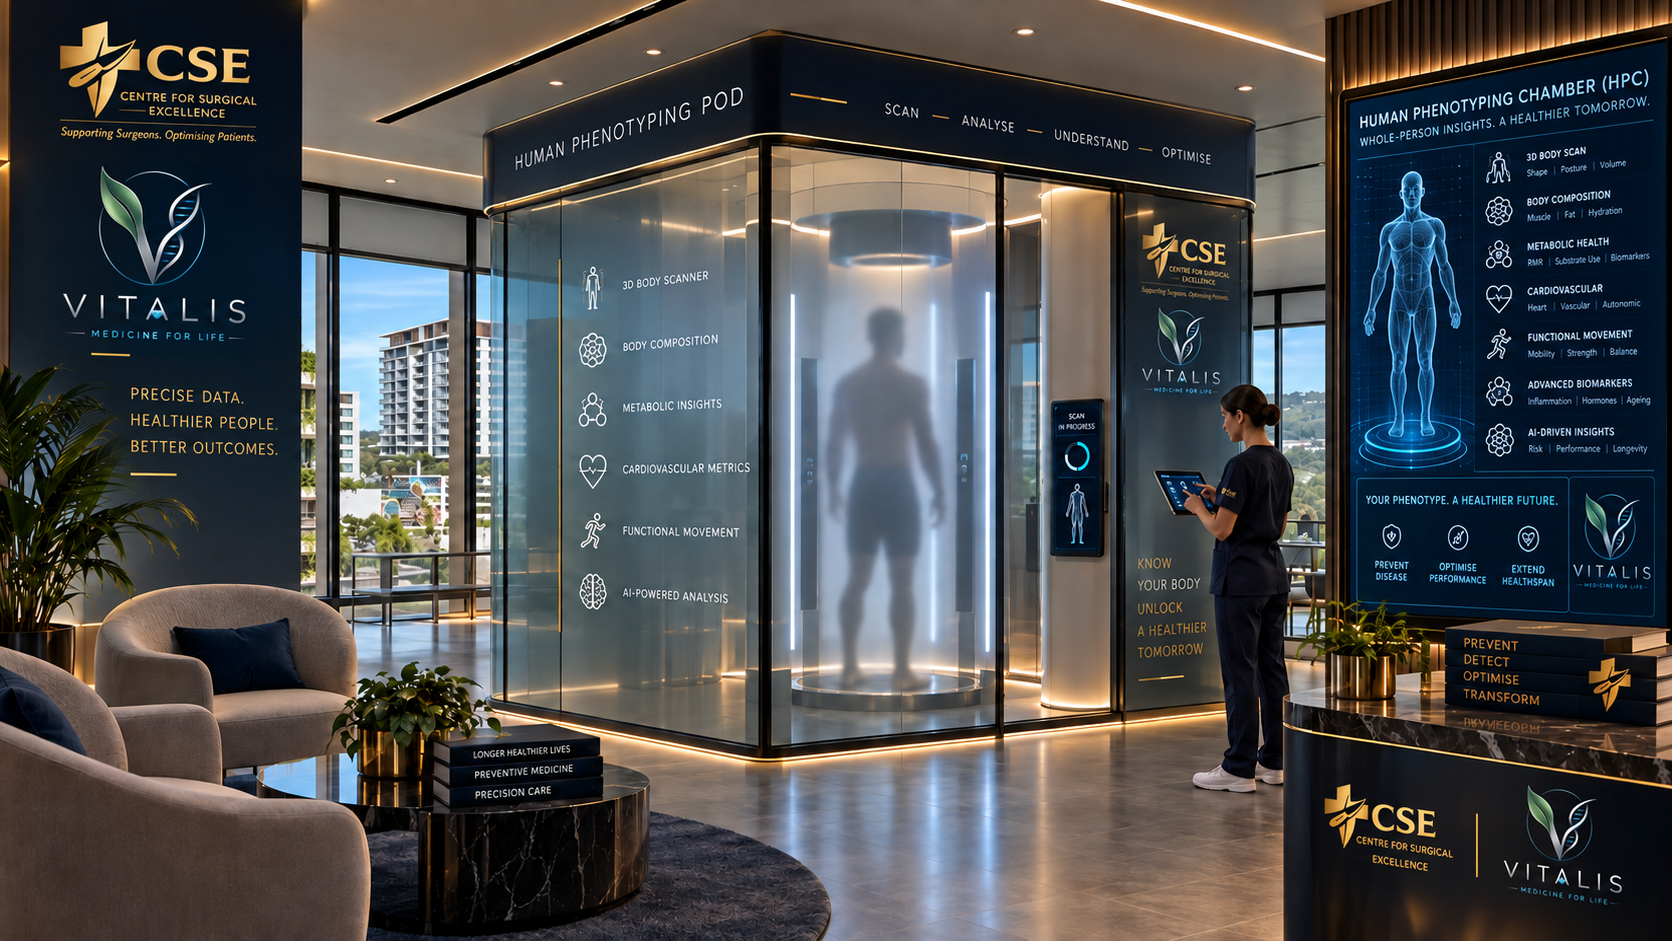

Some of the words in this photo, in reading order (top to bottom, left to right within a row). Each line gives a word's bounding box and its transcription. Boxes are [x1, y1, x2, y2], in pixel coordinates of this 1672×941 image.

[147, 45, 250, 83] CSE
[120, 91, 167, 102] CENTRE
[172, 93, 194, 103] FOR
[199, 94, 257, 106] SURGICAL
[1360, 108, 1408, 129] HUMAN
[1413, 92, 1513, 121] PHENOTYPING
[1518, 79, 1595, 103] CHAMBER
[1602, 69, 1649, 94] (HPC)
[149, 106, 225, 118] EXCELLENCE
[515, 141, 564, 170] HUMAN
[572, 102, 692, 153] PHENOTYPING
[702, 87, 743, 115] POD
[1360, 125, 1439, 147] WHOLE-PERSON
[1443, 118, 1495, 134] INSIGHTS.
[1499, 116, 1506, 126] A
[1510, 107, 1570, 125] HEALTHIER
[1574, 95, 1650, 116] TOMORROW.
[61, 126, 114, 141] Supporting
[116, 128, 162, 141] Surgeons.
[165, 130, 215, 143] Optimising
[217, 132, 257, 142] Patients.
[885, 103, 919, 119] SCAN
[961, 115, 1014, 133] ANALYSE
[1054, 129, 1129, 151] UNDERSTAND
[1162, 147, 1211, 165] OPTIMISE
[1526, 152, 1537, 162] 3D
[1539, 149, 1562, 160] BODY
[1564, 146, 1586, 157] SCAN
[1526, 169, 1548, 177] Shape
[1561, 165, 1587, 173] Posture
[1599, 160, 1627, 169] Volume
[1527, 196, 1549, 206] BODY
[1551, 190, 1611, 204] COMPOSITION
[1527, 212, 1551, 222] Muscle
[1564, 210, 1576, 218] Fat
[1588, 206, 1623, 218] Hydration
[1527, 239, 1574, 251] METABOLIC
[1577, 237, 1609, 247] HEALTH
[1181, 239, 1226, 265] CSE
[1555, 257, 1587, 265] Substrate
[1588, 255, 1601, 263] Use
[1611, 252, 1650, 262] Biomarkers
[1169, 266, 1190, 274] CENTRE
[623, 280, 634, 290] 3D
[637, 276, 661, 288] BODY
[664, 270, 709, 285] SCANNER
[1527, 284, 1603, 296] CARDIOVASCULAR
[63, 293, 246, 323] VITALIS
[1528, 304, 1547, 312] Heart
[1560, 301, 1591, 310] Vascular
[1602, 299, 1641, 308] Autonomic
[91, 330, 158, 340] MEDICINE
[166, 332, 190, 340] FOR
[198, 333, 224, 342] LIFE
[623, 340, 647, 352] BODY
[650, 334, 718, 349] COMPOSITION
[1528, 332, 1581, 342] FUNCTIONAL
[1583, 329, 1633, 340] MOVEMENT
[1528, 350, 1555, 359] Mobility
[1567, 348, 1597, 359] Strength
[1610, 347, 1638, 356] Balance
[1142, 368, 1220, 385] VITALIS
[1528, 379, 1574, 389] ADVANCED
[1576, 378, 1633, 388] BIOMARKERS
[131, 387, 194, 402] PRECISE
[203, 390, 244, 404] DATA.
[1528, 397, 1572, 405] Inflammation
[1582, 396, 1617, 405] Hormones
[1626, 395, 1651, 406] Ageing
[623, 401, 674, 412] METABOLIC
[677, 398, 722, 410] INSIGHTS
[131, 413, 213, 428] HEALTHIER
[220, 416, 278, 430] PEOPLE.
[1528, 427, 1572, 437] AI-DRIVEN
[1574, 427, 1615, 436] INSIGHTS
[131, 440, 186, 454] BETTER
[193, 441, 278, 456] OUTCOMES.
[1528, 444, 1543, 453] Risk
[1556, 444, 1601, 453] Performance
[1613, 444, 1648, 455] Longevity
[623, 463, 705, 474] CARDIOVASCULAR
[708, 462, 750, 473] METRICS
[1366, 495, 1390, 505] YOUR
[1393, 495, 1449, 505] PHENOTYPE.
[1452, 495, 1459, 505] A
[1462, 495, 1514, 505] HEALTHIER
[1517, 495, 1558, 505] FUTURE.
[623, 526, 680, 537] FUNCTIONAL
[683, 527, 740, 538] MOVEMENT
[1137, 556, 1172, 570] KNOW
[1375, 560, 1409, 570] PREVENT
[1439, 562, 1477, 572] OPTIMISE
[1512, 564, 1545, 574] EXTEND
[1376, 572, 1407, 581] DISEASE
[1429, 574, 1486, 584] PERFORMANCE
[1573, 564, 1651, 580] VITALIS
[1137, 579, 1167, 591] YOUR
[1171, 577, 1201, 590] BODY
[1502, 577, 1555, 587] HEALTHSPAN
[623, 588, 680, 600] AI-POWERED
[682, 591, 728, 604] ANALYSIS
[1138, 601, 1183, 615] UNLOCK
[1137, 626, 1145, 637] A
[1149, 621, 1207, 636] HEALTHIER
[1137, 642, 1204, 658] TOMORROW
[1464, 637, 1519, 651] PREVENT
[1464, 654, 1510, 667] DETECT
[1463, 670, 1519, 685] OPTIMISE
[1463, 688, 1539, 706] TRANSFORM
[473, 749, 505, 759] LONGER
[507, 746, 548, 756] HEALTHIER
[550, 744, 571, 754] LIVES
[474, 767, 528, 779] PREVENTIVE
[531, 764, 573, 775] MEDICINE
[475, 788, 525, 799] PRECISION
[528, 786, 551, 796] CARE
[1372, 804, 1436, 838] CSE
[1356, 835, 1389, 848] CENTRE
[1391, 841, 1408, 851] FOR
[1410, 844, 1453, 858] SURGICAL
[1372, 855, 1428, 872] EXCELLENCE
[1503, 860, 1622, 894] VITALIS
[1520, 886, 1563, 899] MEDICINE
[1568, 893, 1585, 901] FOR
[1589, 897, 1608, 905] LIFE
